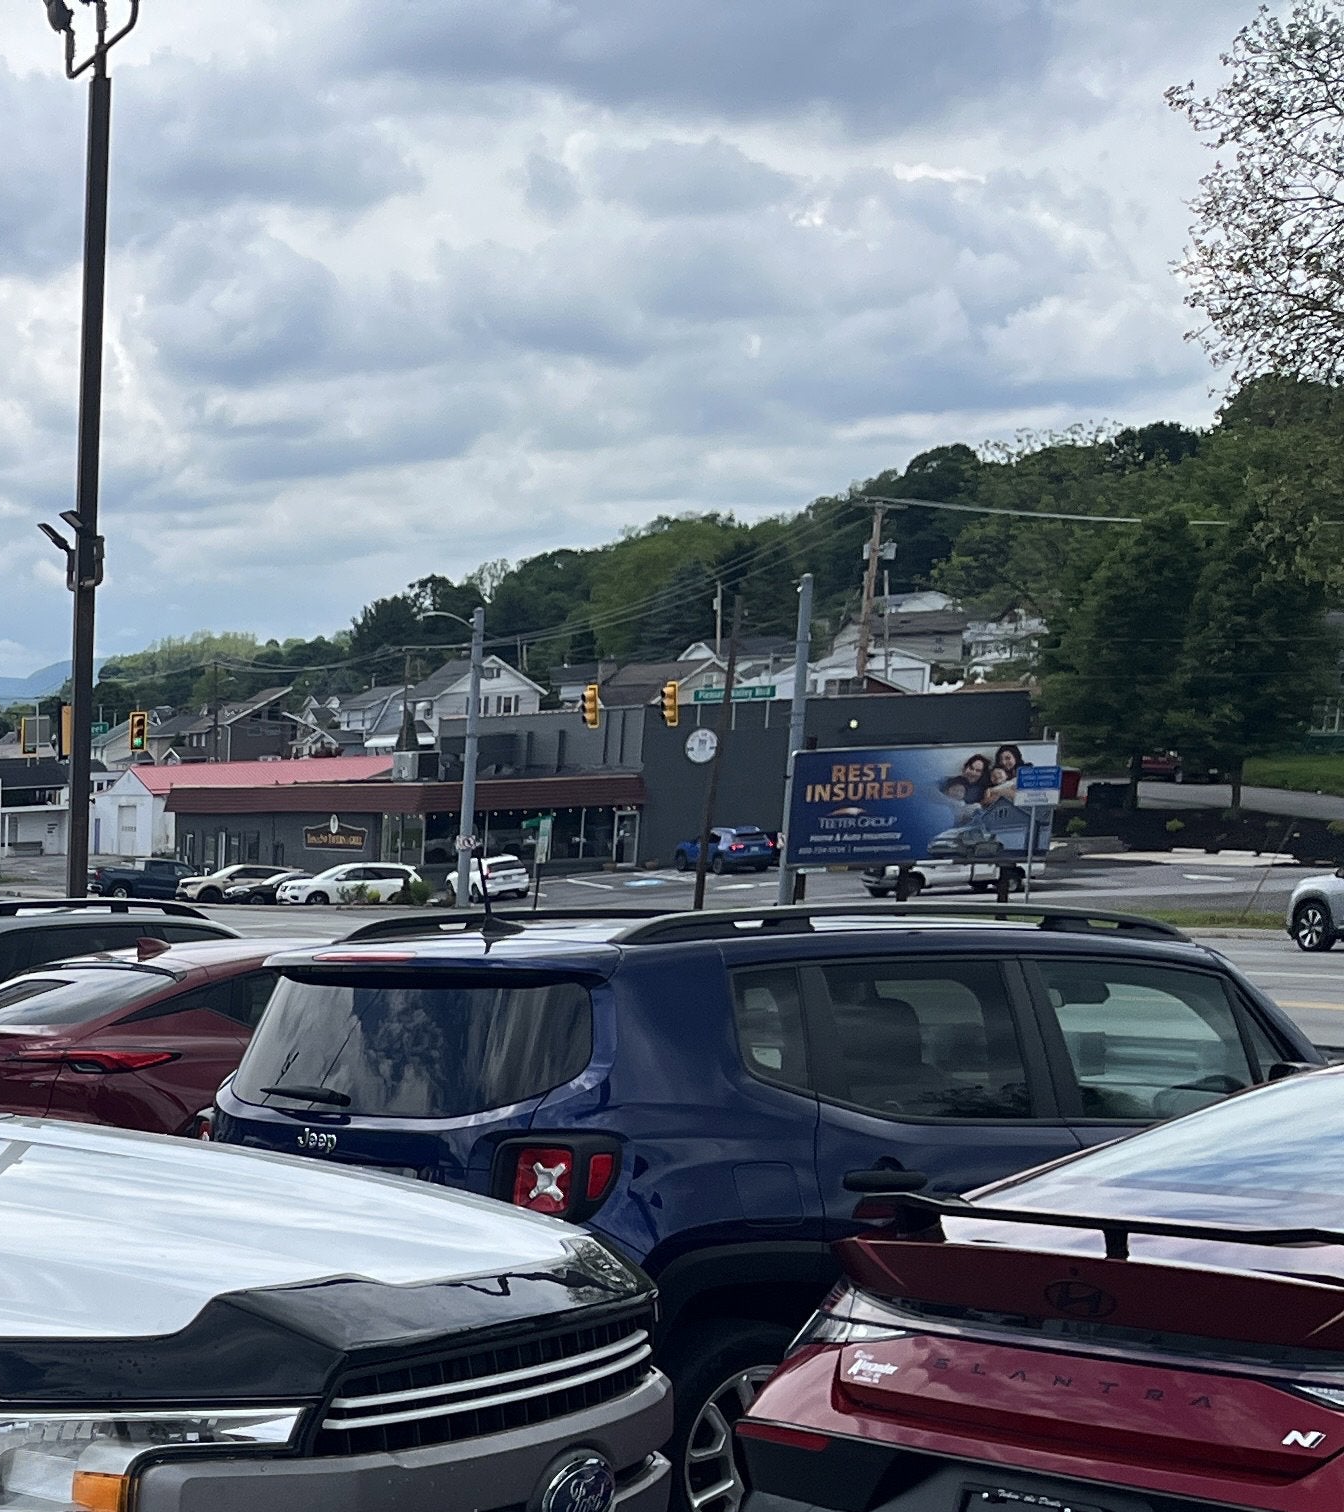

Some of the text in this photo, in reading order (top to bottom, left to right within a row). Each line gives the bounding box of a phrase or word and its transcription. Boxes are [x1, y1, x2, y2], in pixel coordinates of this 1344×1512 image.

[831, 763, 892, 782] REST
[805, 781, 915, 803] INSURED
[297, 1127, 337, 1153] Jeep
[932, 1357, 1213, 1409] ELANTRA
